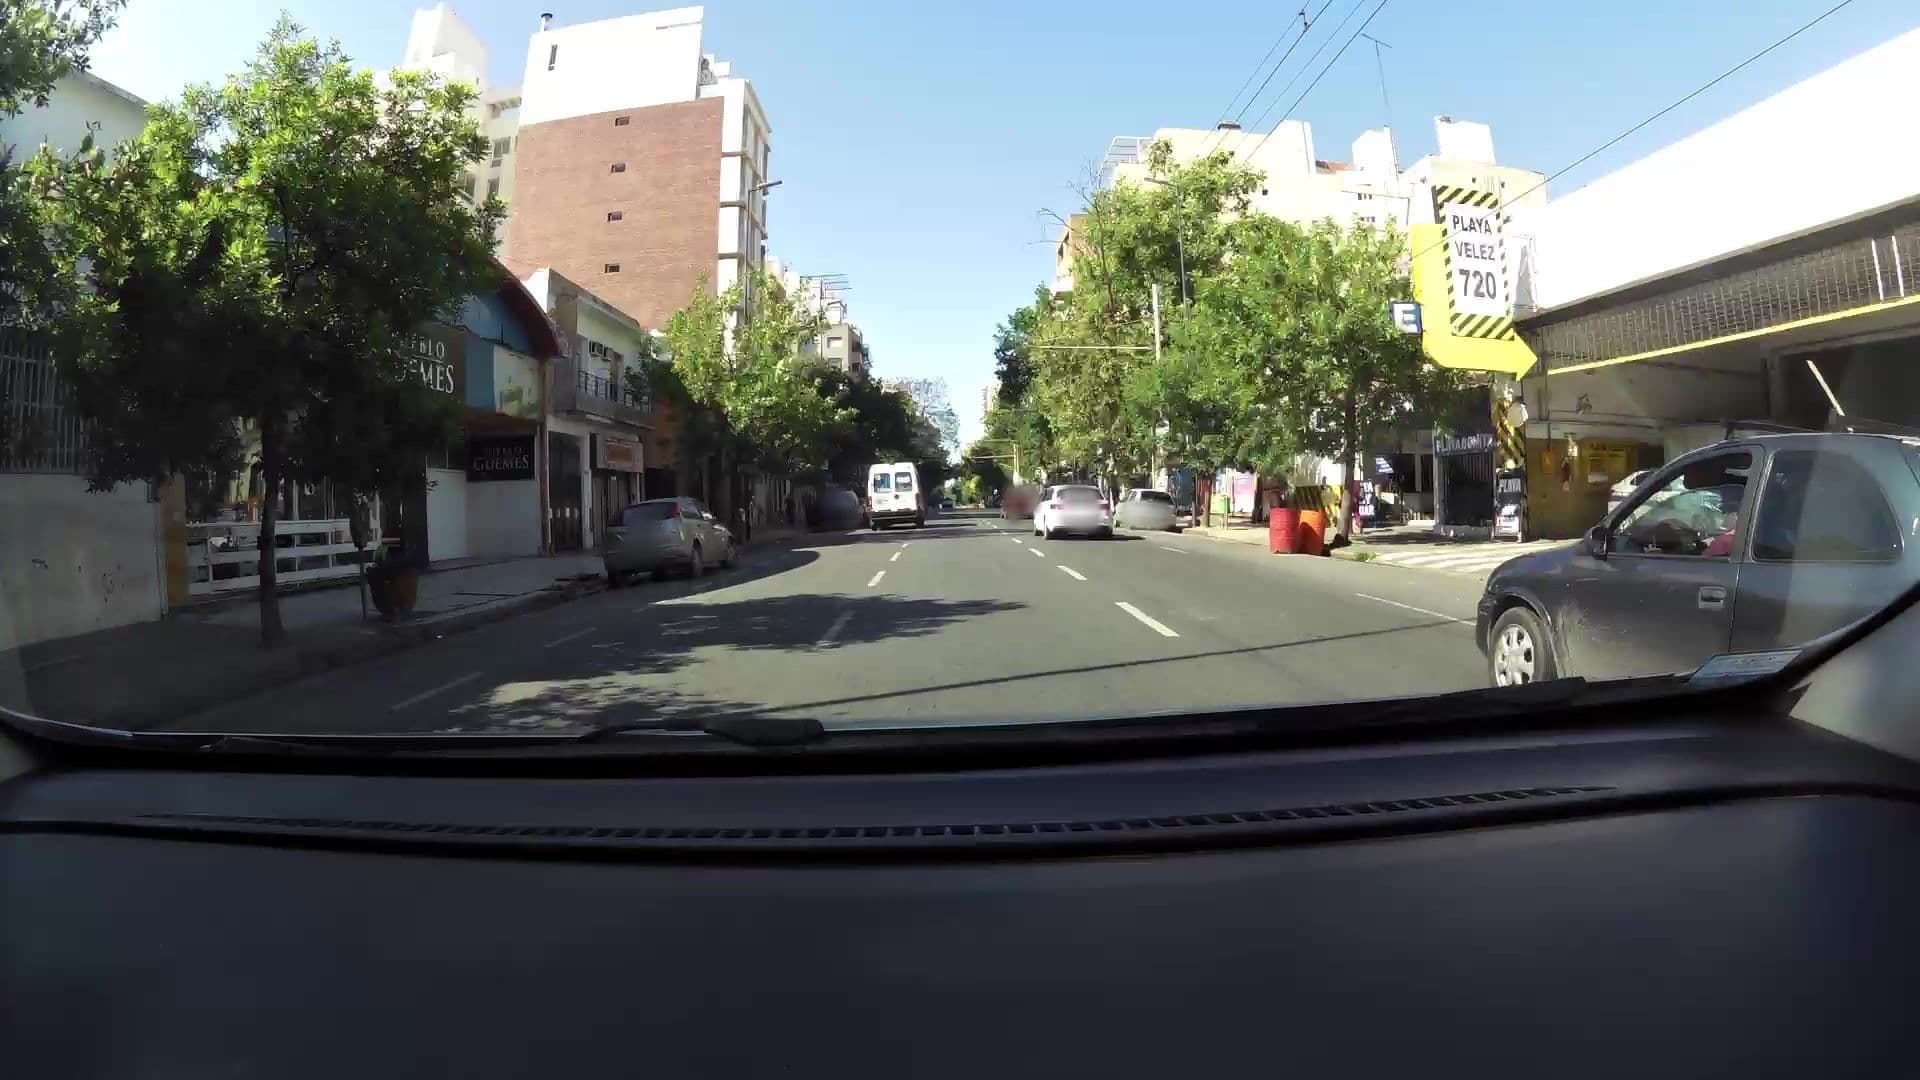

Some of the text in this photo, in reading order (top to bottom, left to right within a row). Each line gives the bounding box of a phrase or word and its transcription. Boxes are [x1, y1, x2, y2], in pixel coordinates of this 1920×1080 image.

[1452, 215, 1493, 235] PLAYA
[1455, 240, 1496, 260] VELEZ
[1459, 269, 1497, 299] 720
